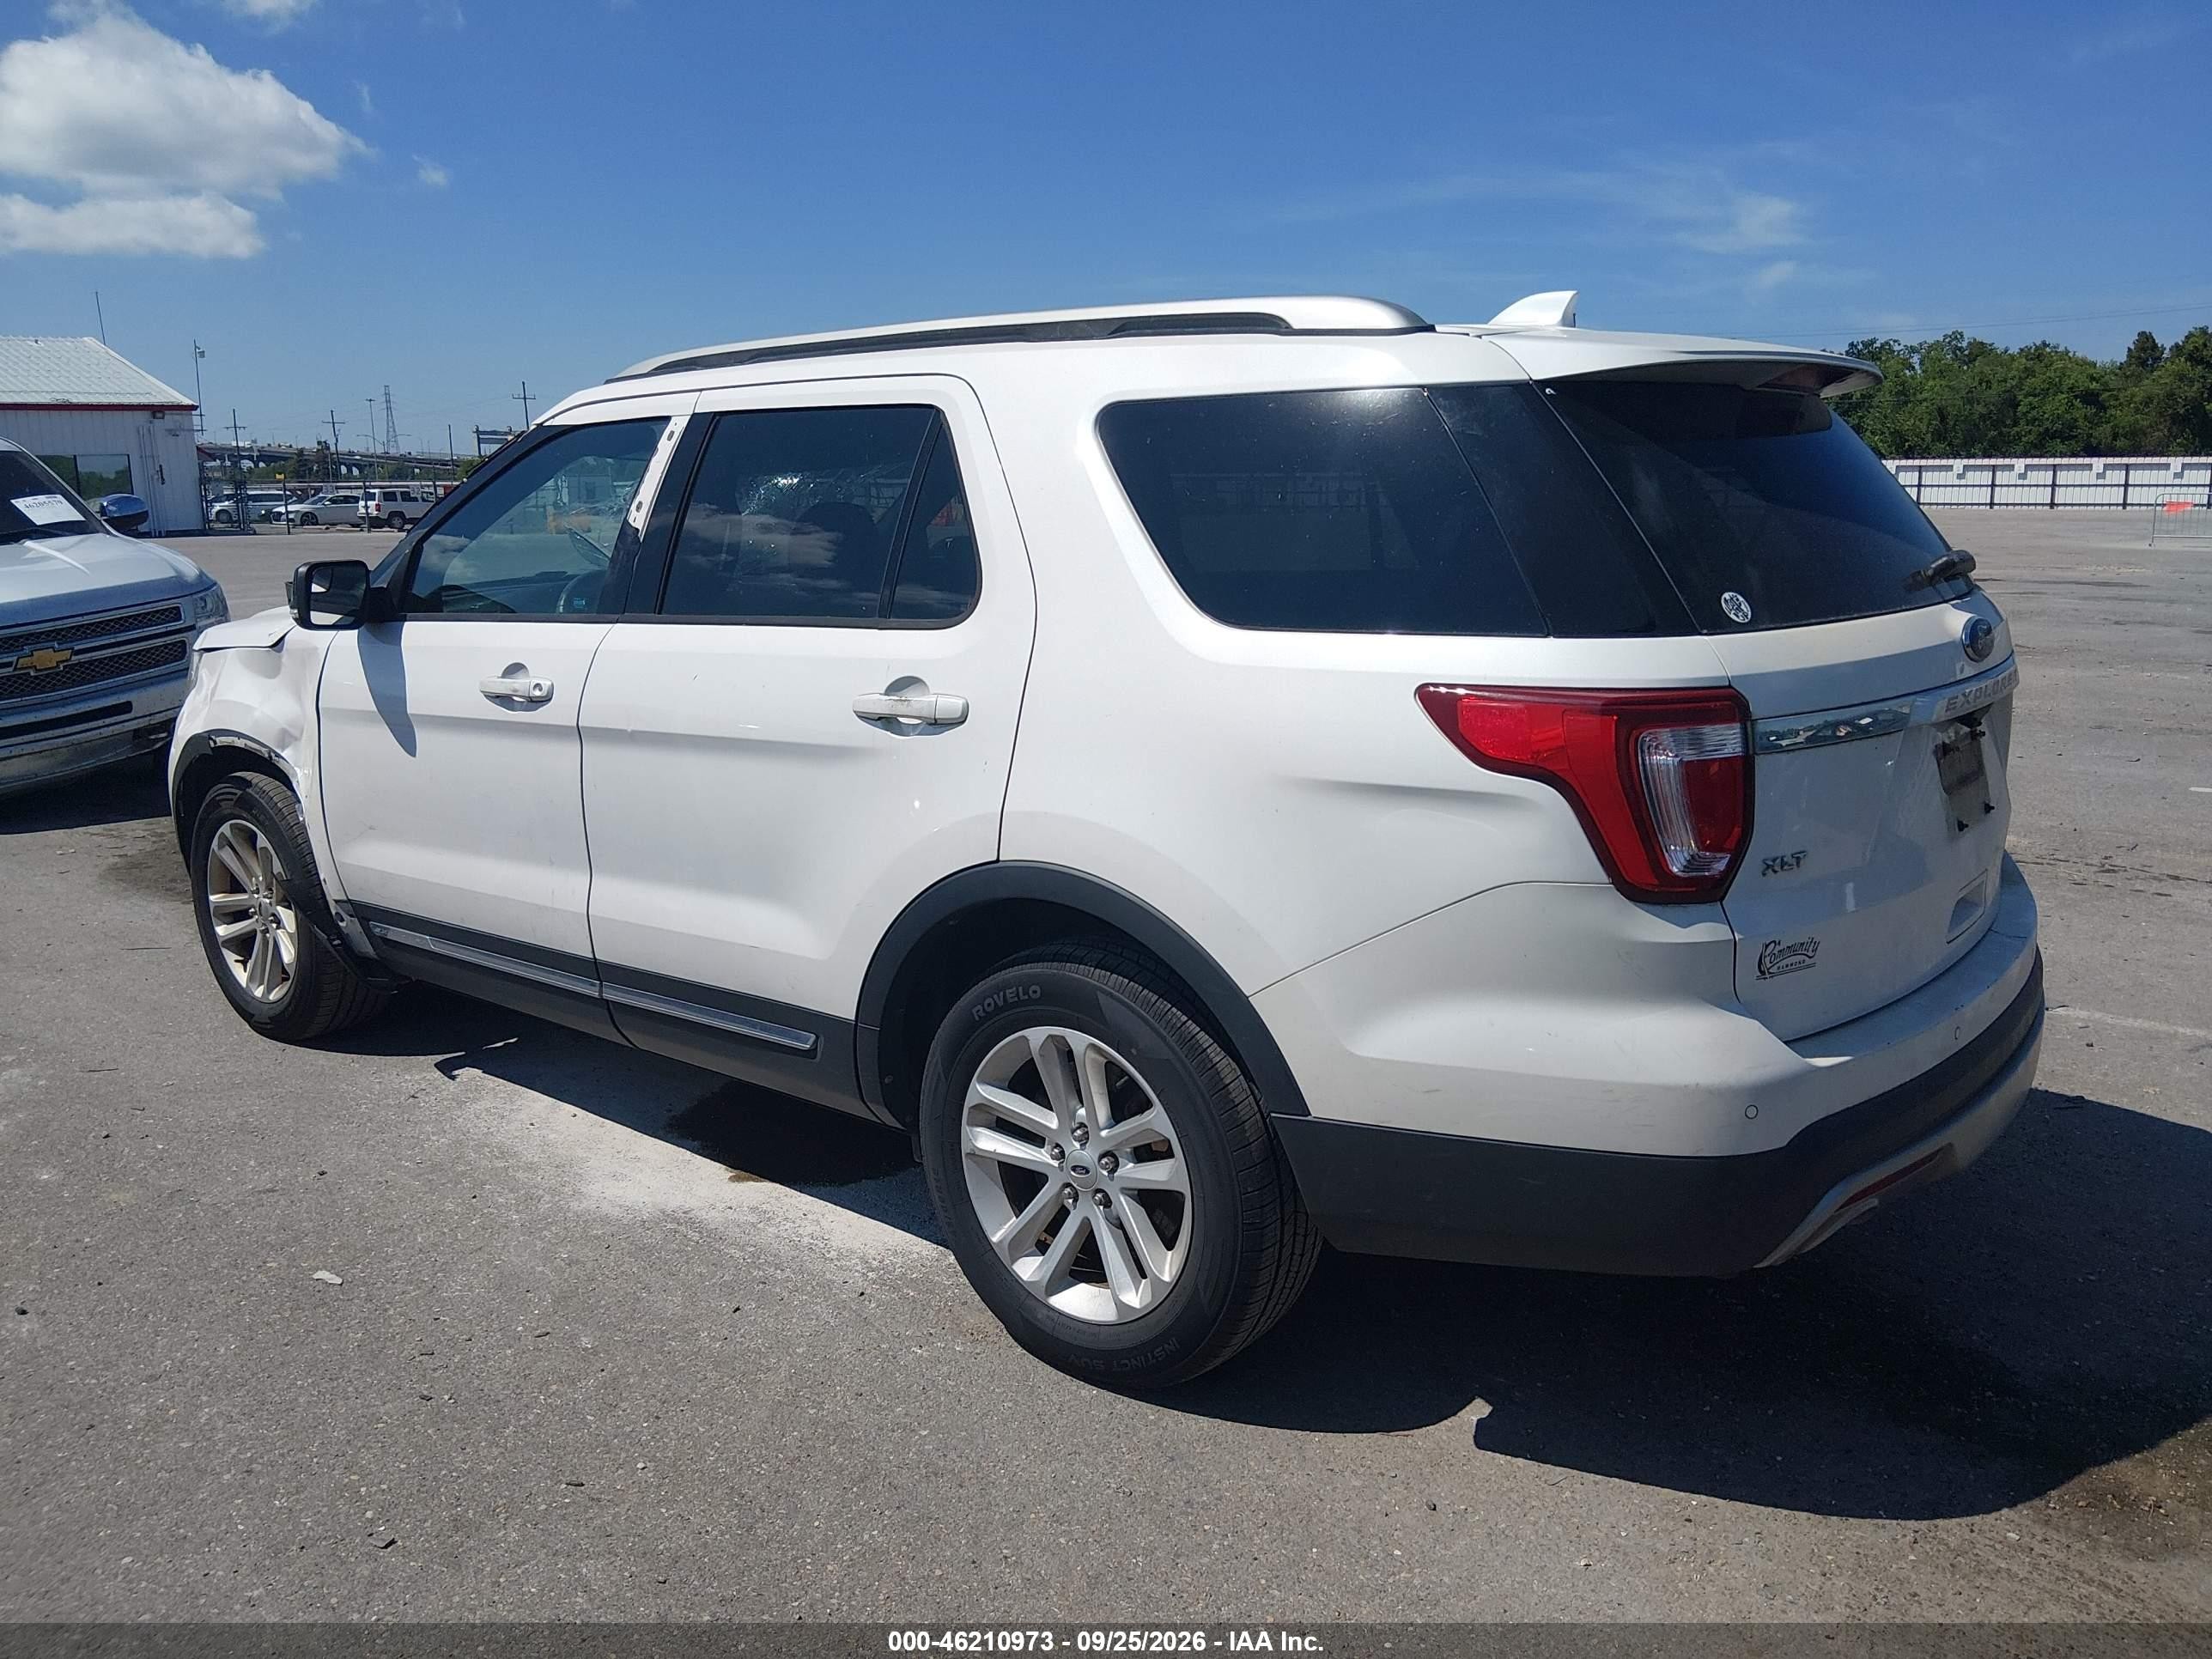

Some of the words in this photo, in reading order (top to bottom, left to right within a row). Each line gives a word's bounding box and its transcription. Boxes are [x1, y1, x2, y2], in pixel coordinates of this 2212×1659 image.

[1761, 850, 1807, 877] XLT
[1758, 937, 1820, 976] Community
[972, 985, 1042, 1021] ROVELO
[1111, 1337, 1181, 1372] INSTINCT
